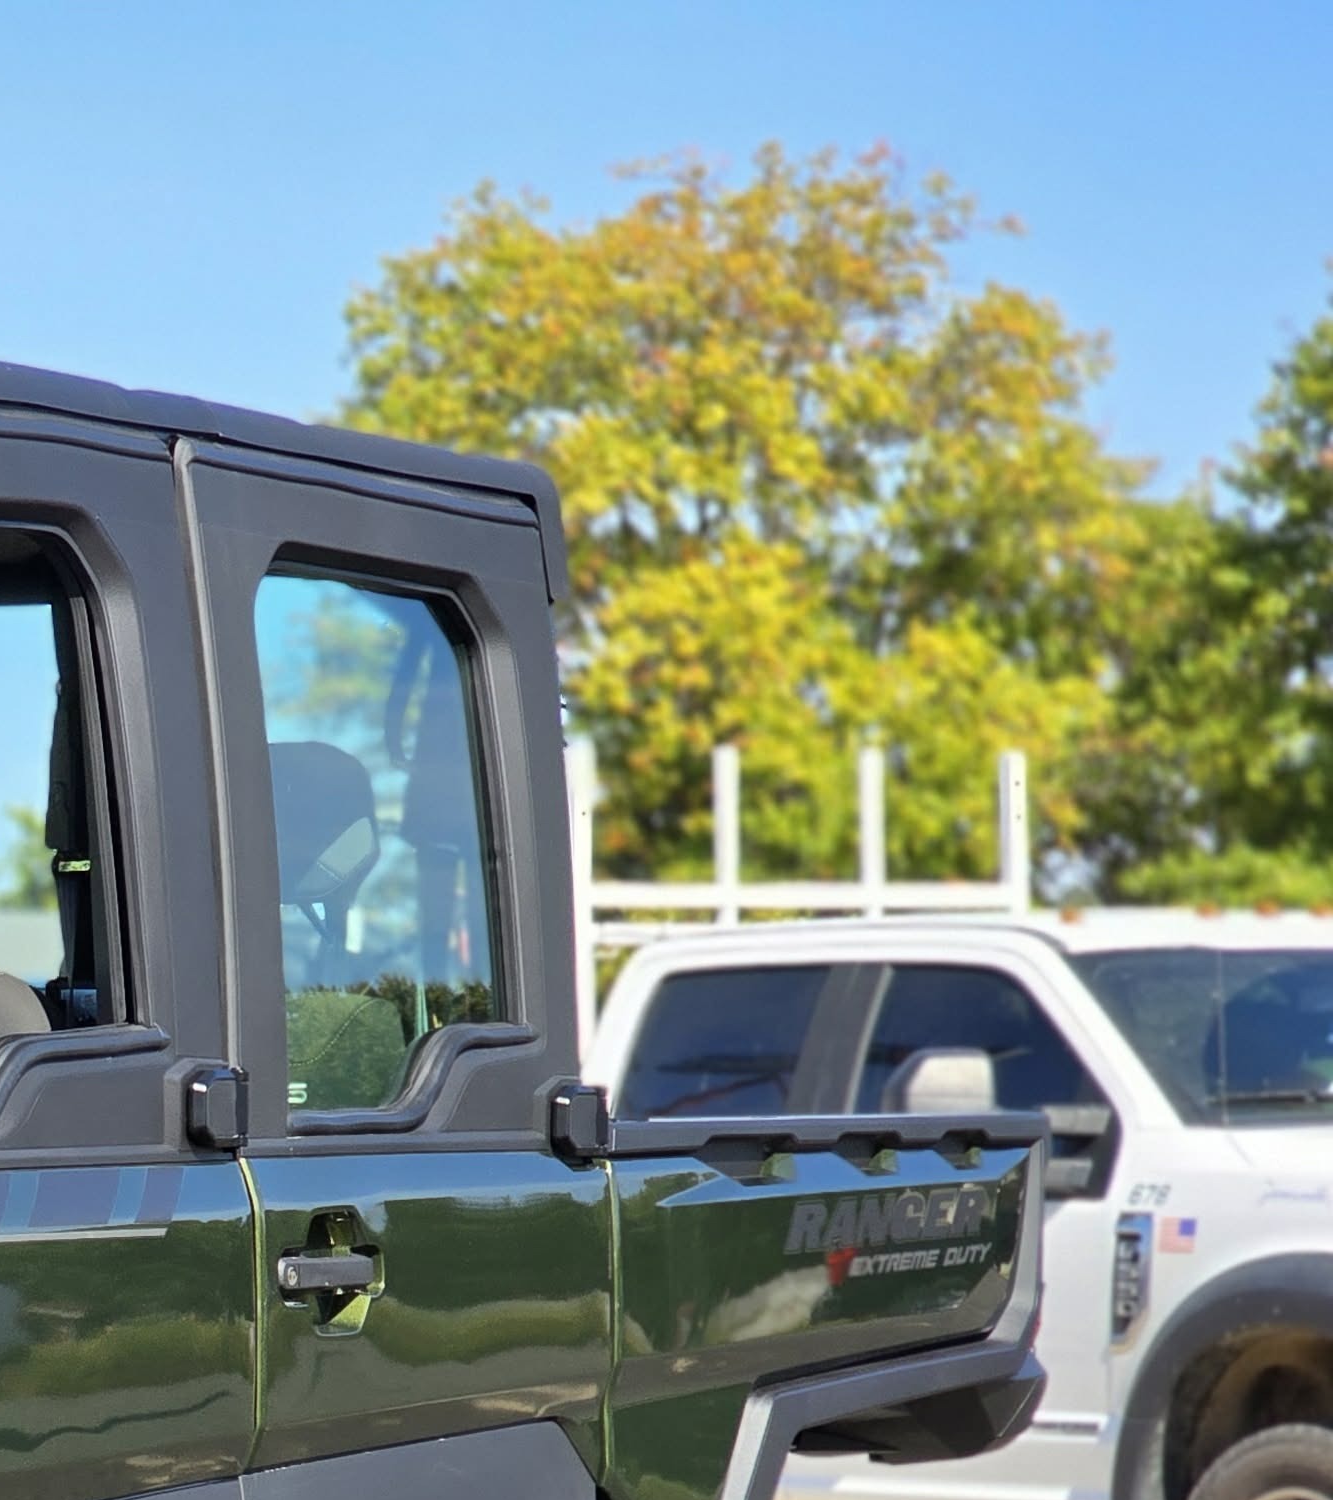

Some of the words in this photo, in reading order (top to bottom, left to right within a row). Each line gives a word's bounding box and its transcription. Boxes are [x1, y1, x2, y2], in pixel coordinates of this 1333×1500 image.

[783, 1185, 993, 1256] RANGER
[848, 1249, 941, 1278] EXTREME
[943, 1242, 993, 1268] DUTY
